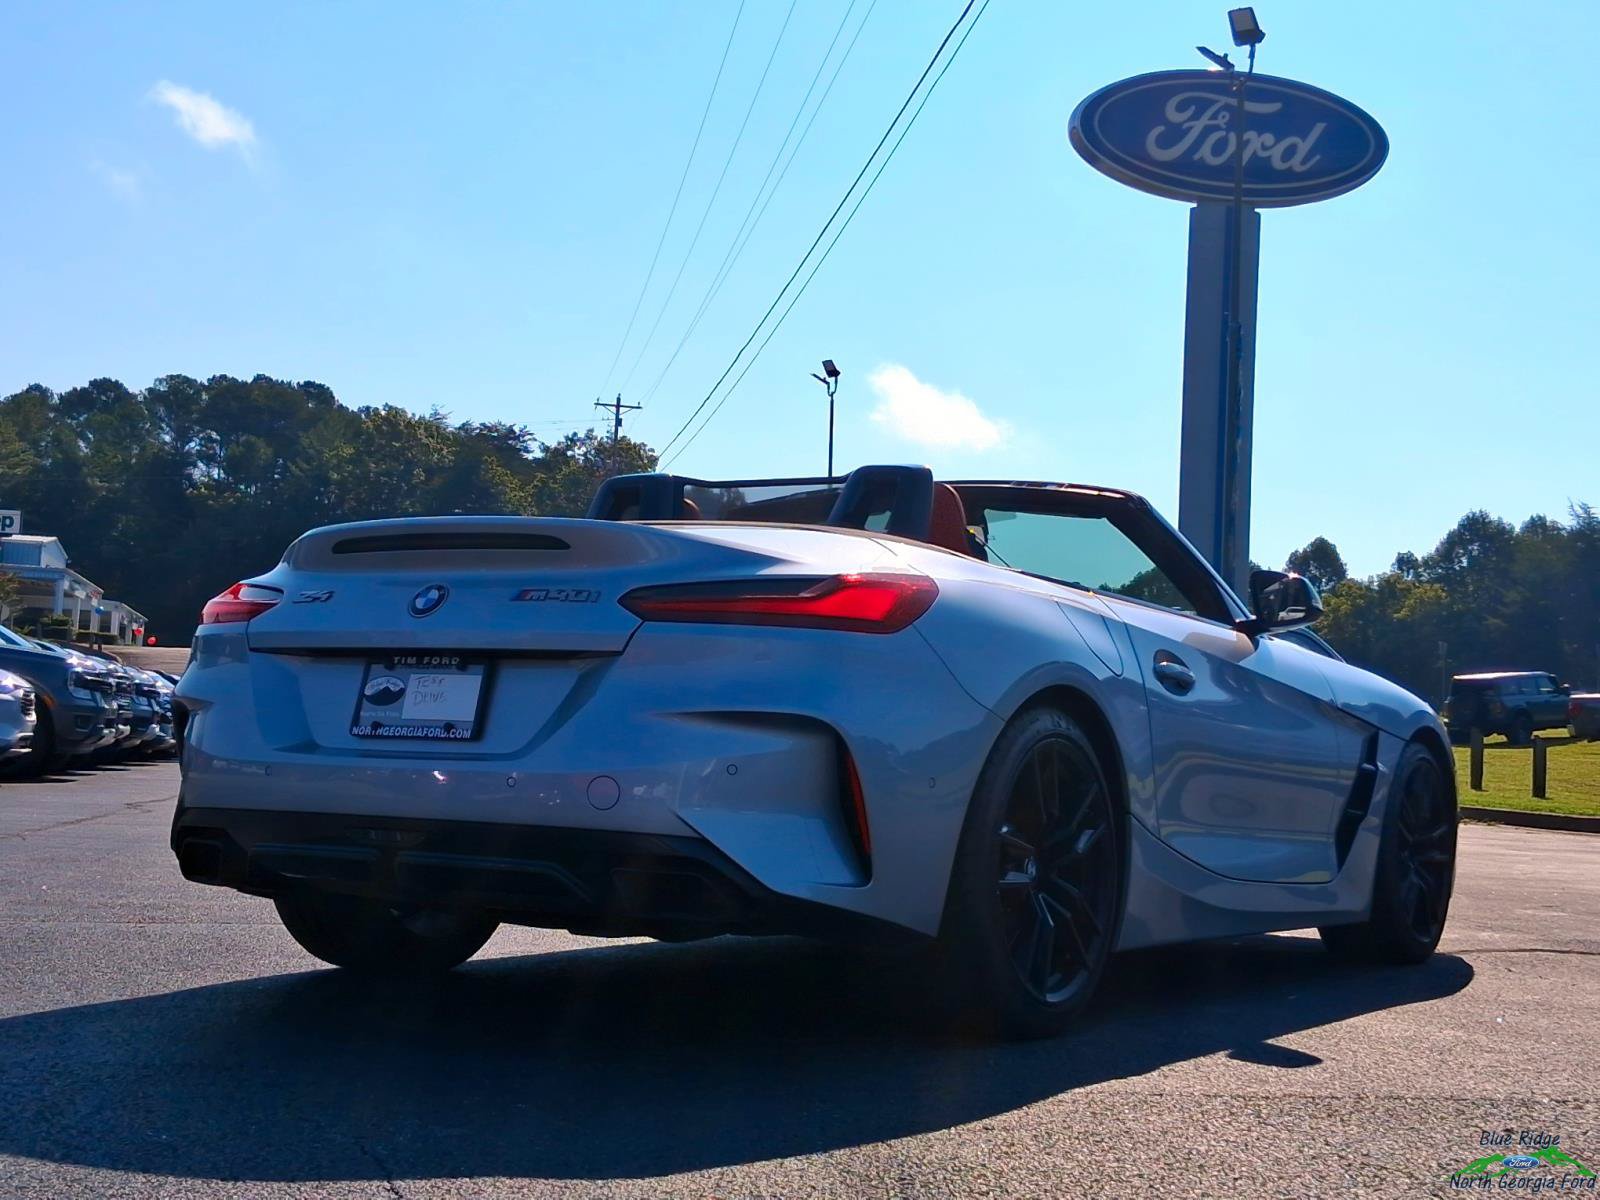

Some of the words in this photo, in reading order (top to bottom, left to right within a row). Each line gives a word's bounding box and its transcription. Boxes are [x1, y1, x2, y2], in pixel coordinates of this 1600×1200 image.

[1145, 91, 1328, 173] Ford
[0, 515, 15, 532] p
[392, 655, 417, 665] TIM
[423, 655, 461, 666] FORD
